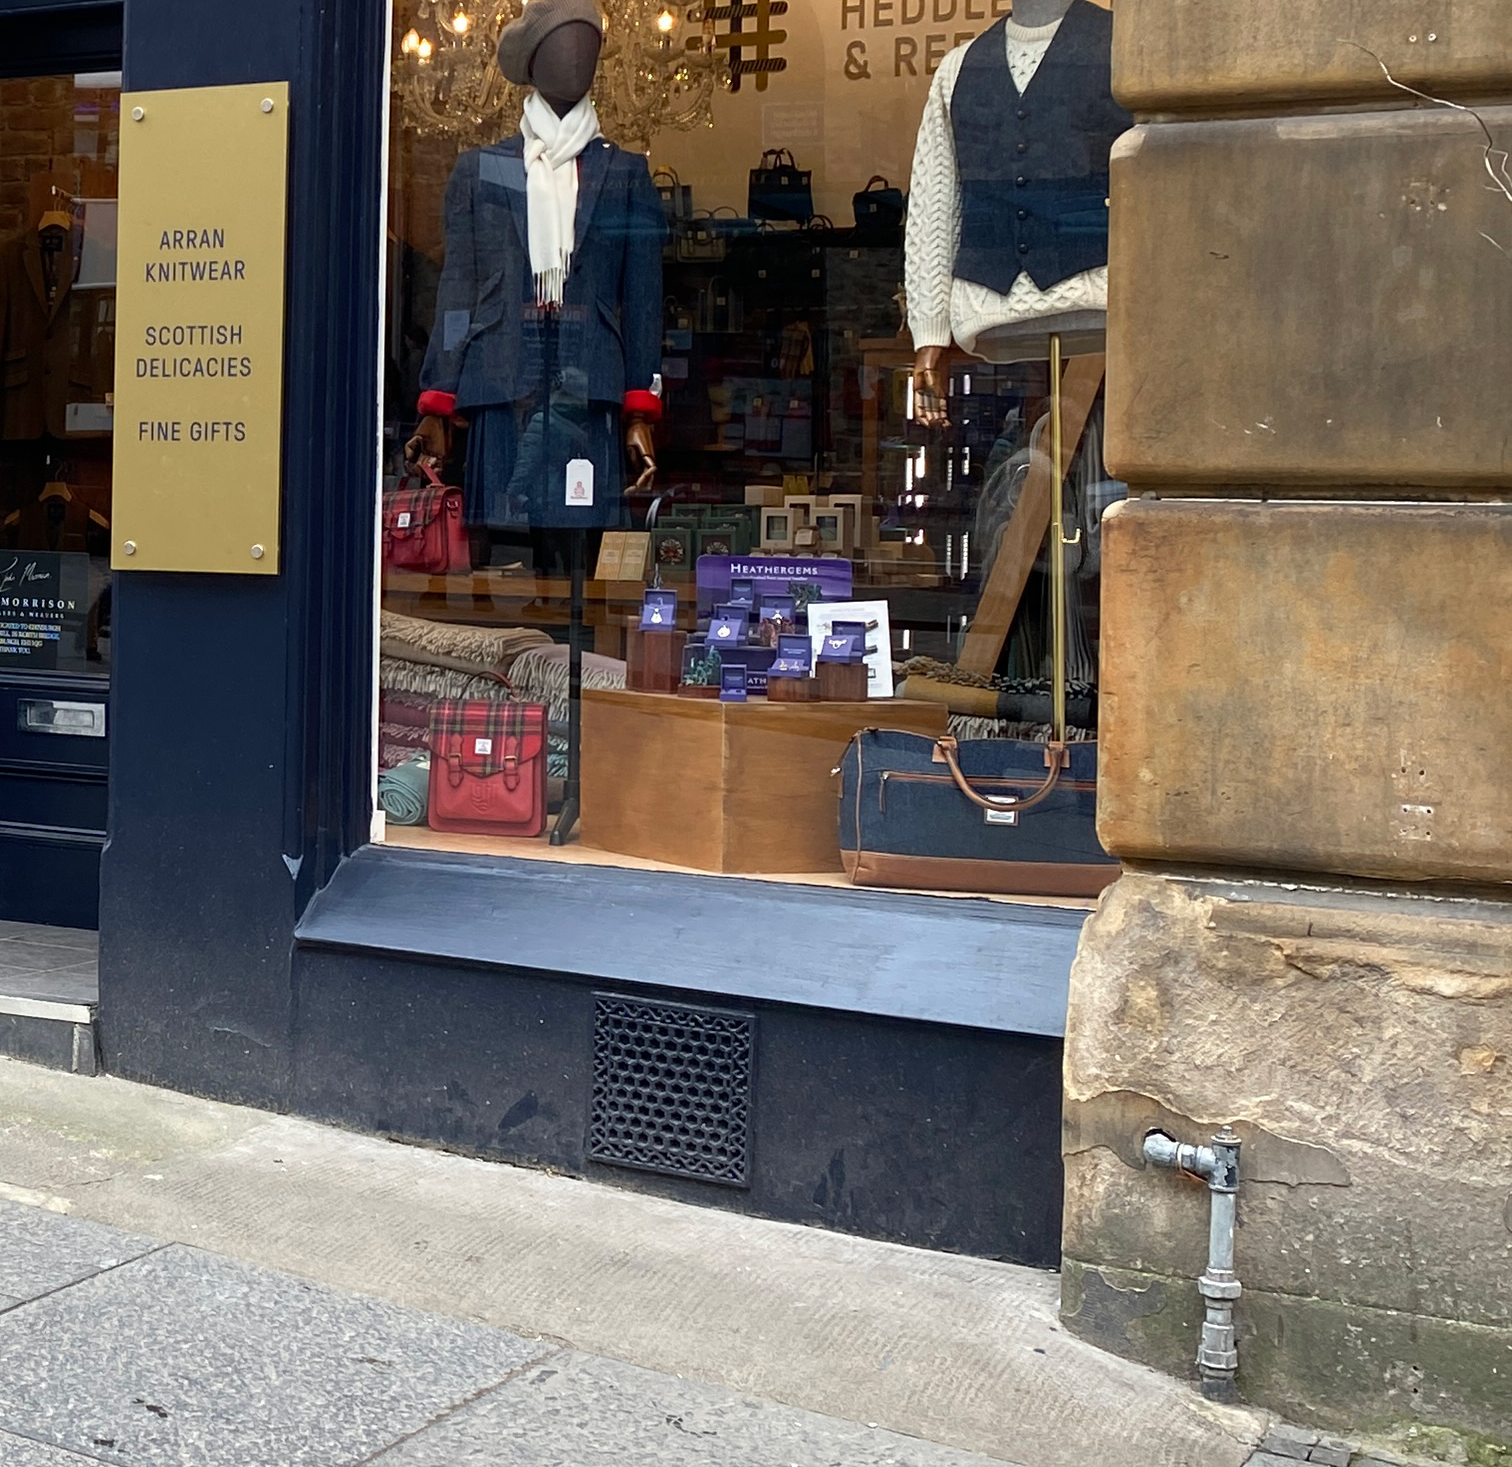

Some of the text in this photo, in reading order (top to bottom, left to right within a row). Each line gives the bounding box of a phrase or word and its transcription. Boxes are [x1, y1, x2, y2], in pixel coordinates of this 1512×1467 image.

[844, 40, 872, 80] &
[159, 228, 225, 250] ARRAN
[145, 260, 246, 283] KNITWEAR
[145, 325, 242, 346] SCOTTISH
[136, 357, 252, 378] DELICACIES
[139, 421, 246, 442] FINE GIFTS
[1, 597, 76, 610] MORRISON
